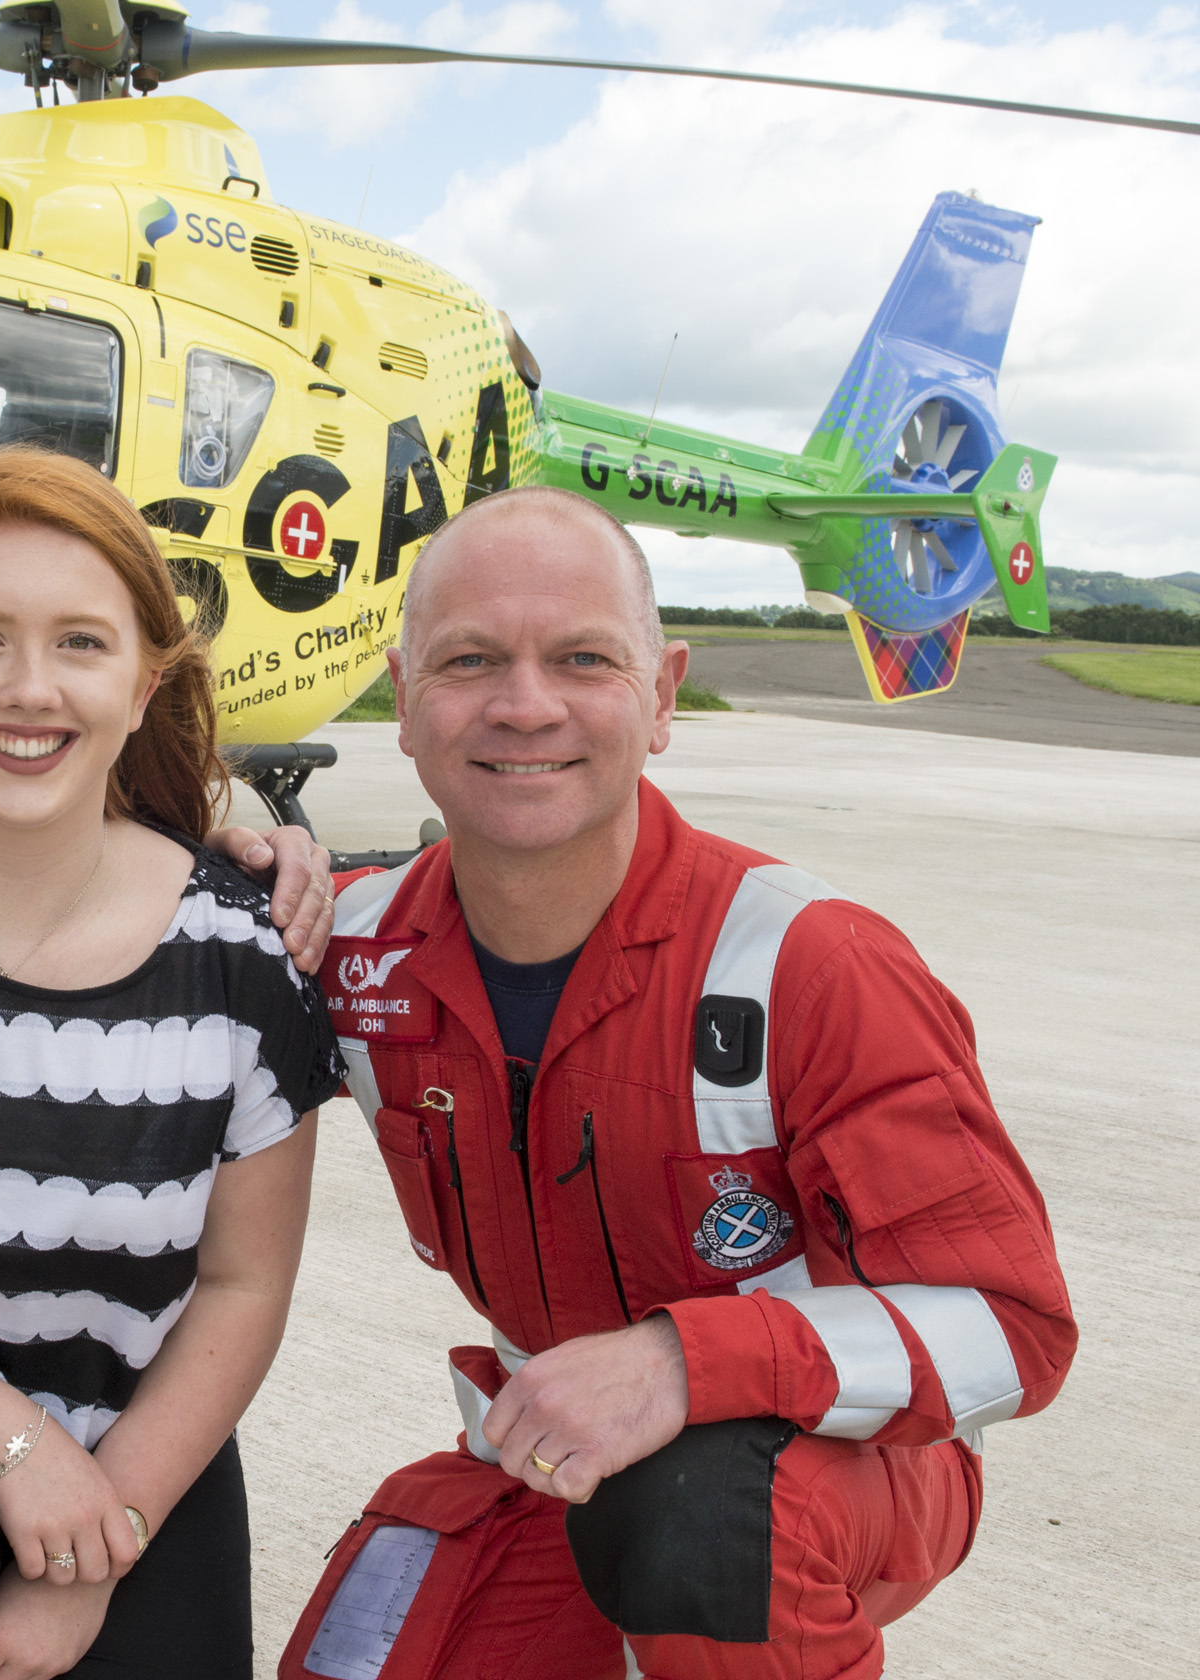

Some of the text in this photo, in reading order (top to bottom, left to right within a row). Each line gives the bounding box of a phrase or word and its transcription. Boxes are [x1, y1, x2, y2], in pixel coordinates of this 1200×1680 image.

[186, 213, 246, 253] sse
[310, 225, 424, 267] STAGECOACH
[581, 442, 738, 518] G-SCAA
[295, 606, 388, 660] Charity
[216, 632, 397, 714] Funded by the people
[347, 954, 365, 978] A
[327, 996, 411, 1014] AIR AMBULANCE
[714, 1194, 769, 1214] AMBULANCE
[705, 1212, 725, 1251] SCOTTISH
